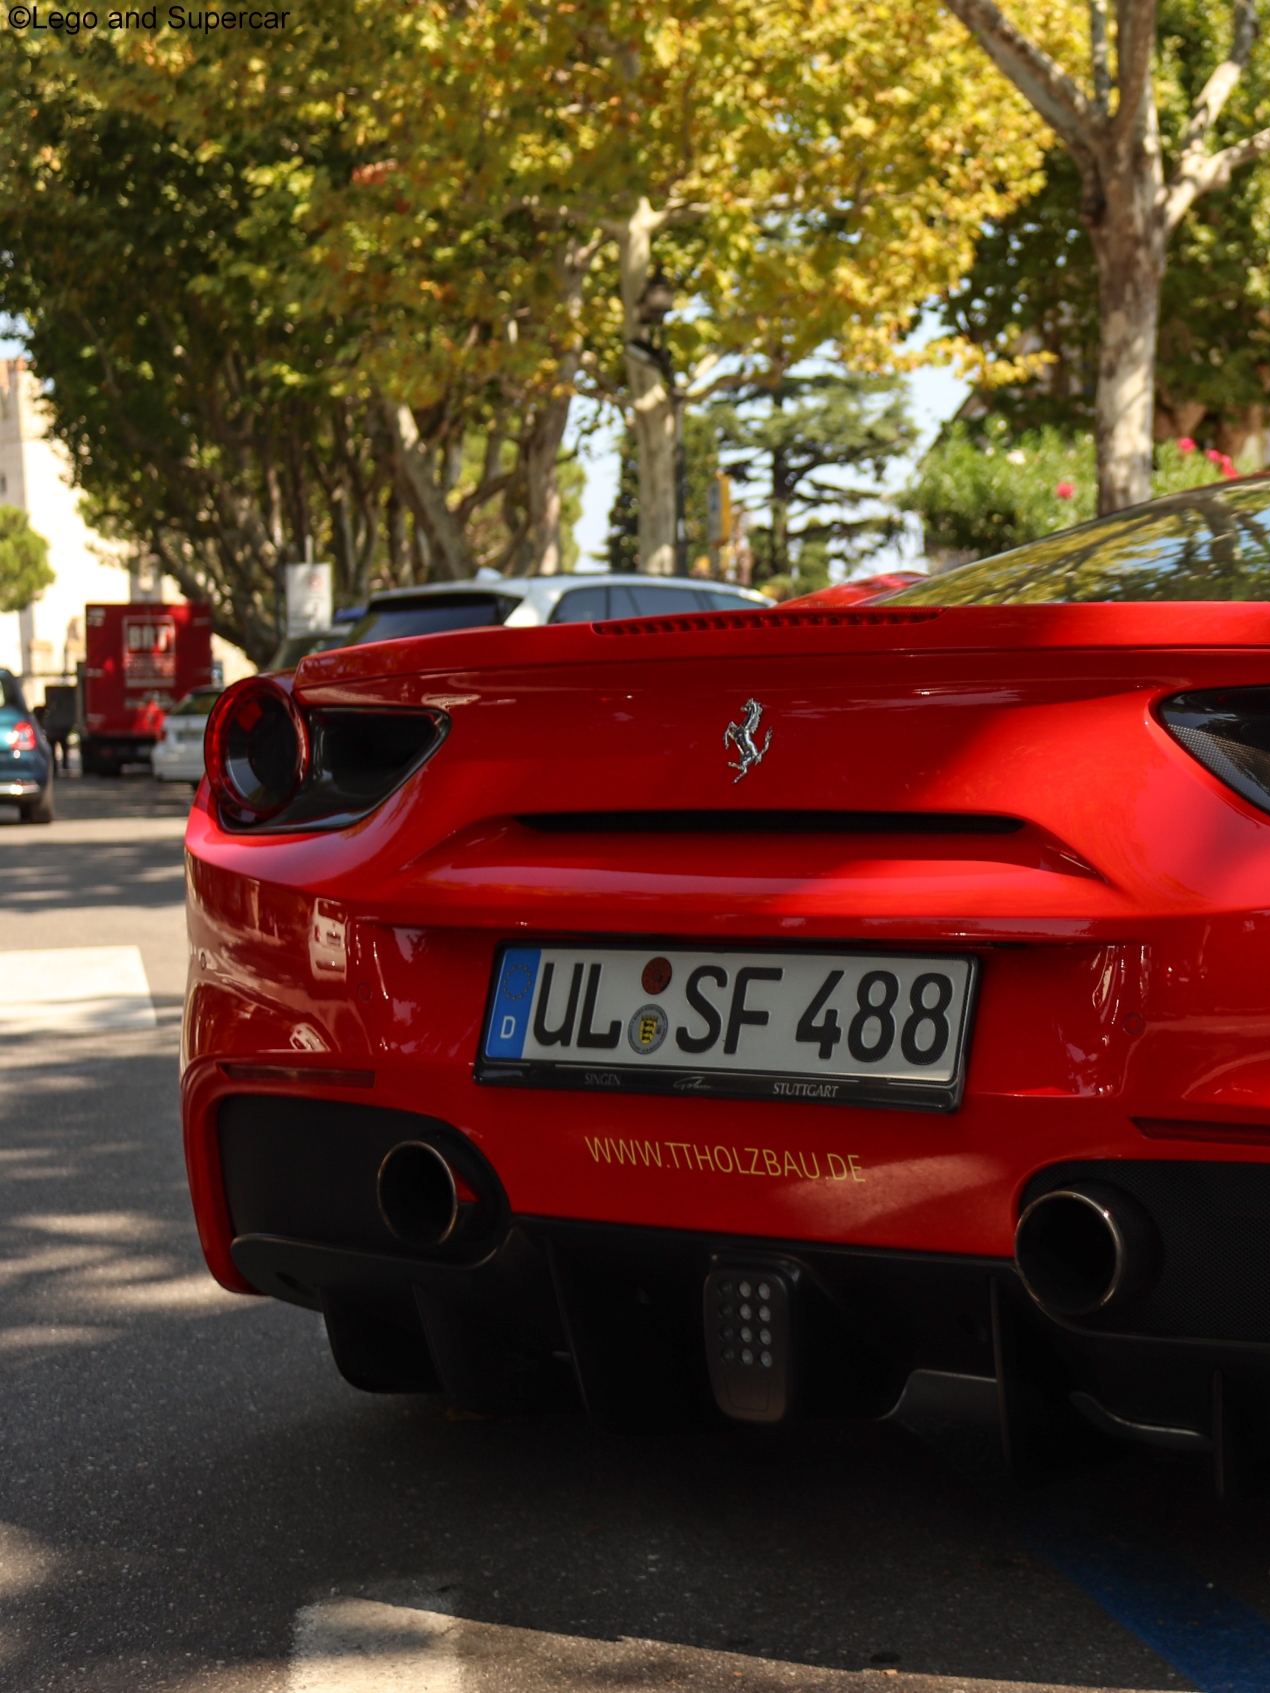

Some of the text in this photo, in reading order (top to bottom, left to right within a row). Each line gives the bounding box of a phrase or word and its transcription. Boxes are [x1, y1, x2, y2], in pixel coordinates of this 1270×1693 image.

[500, 1015, 516, 1039] D
[533, 962, 622, 1048] UL
[675, 965, 783, 1054] SF
[795, 970, 953, 1066] 488
[584, 1072, 621, 1086] SINGEN
[772, 1082, 839, 1098] STUTTGART
[585, 1136, 866, 1182] WWW.TTHOLZBAU.DE
